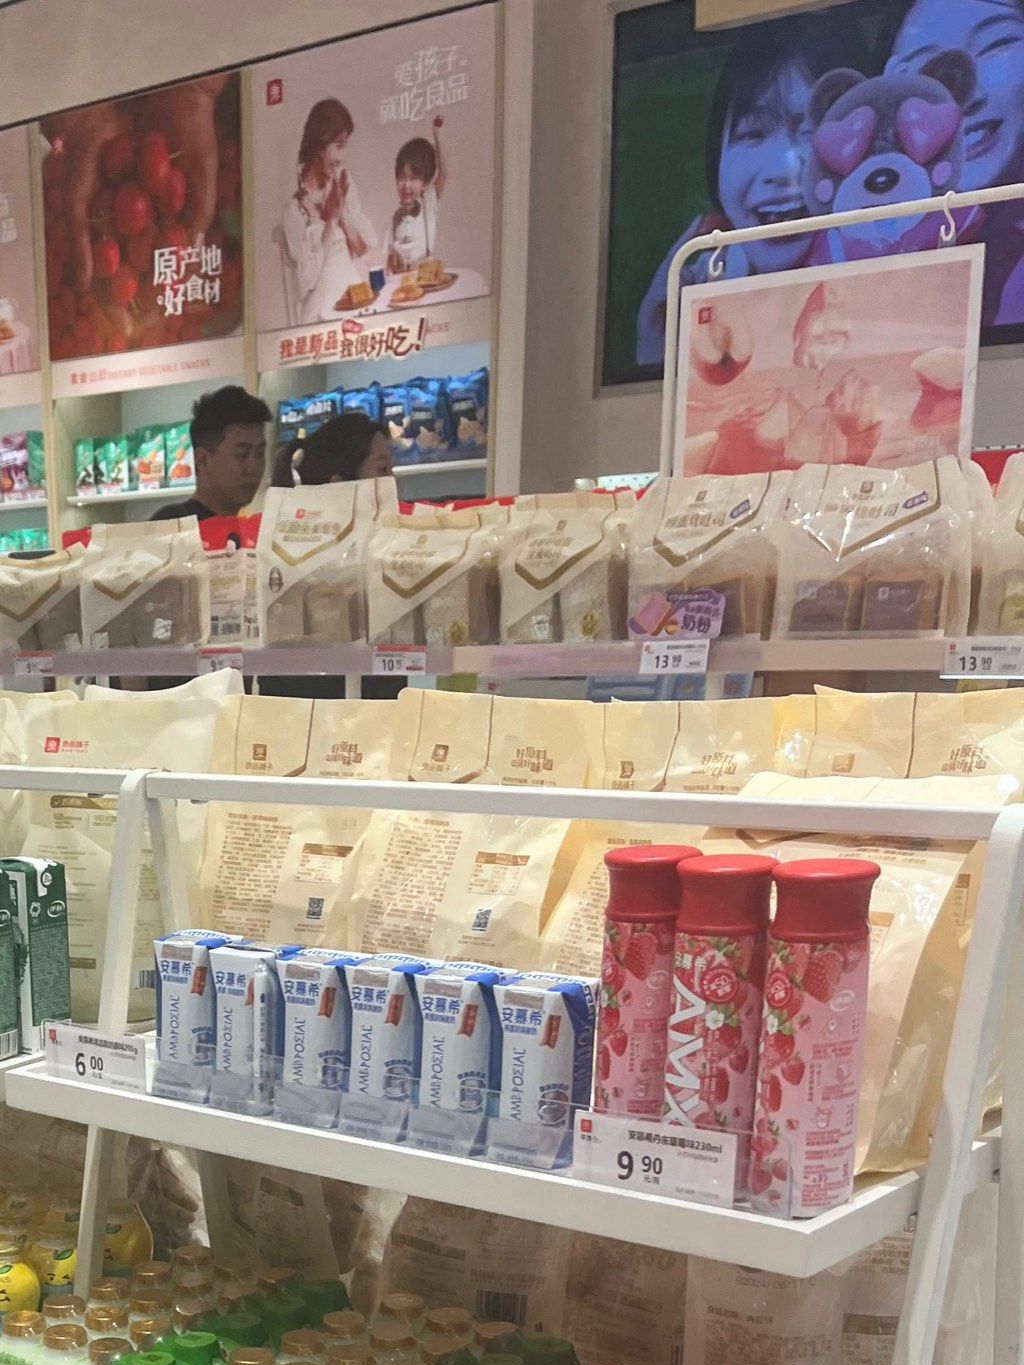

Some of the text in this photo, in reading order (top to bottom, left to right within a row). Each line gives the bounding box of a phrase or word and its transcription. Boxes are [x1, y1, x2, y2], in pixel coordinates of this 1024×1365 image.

[153, 244, 223, 285] 原产地
[163, 276, 221, 317] 好食材
[279, 329, 338, 363] 我是新品
[381, 658, 394, 672] 10
[654, 654, 669, 669] 13
[959, 655, 977, 671] 13
[160, 959, 192, 977] 安慕希
[216, 970, 246, 988] 安慕希
[284, 980, 320, 997] 安慕希
[351, 985, 387, 1004] 安慕希
[422, 996, 460, 1016] 安慕希
[501, 1006, 542, 1026] 安慕希
[75, 1052, 104, 1076] 6 00
[617, 1150, 663, 1180] 9 90
